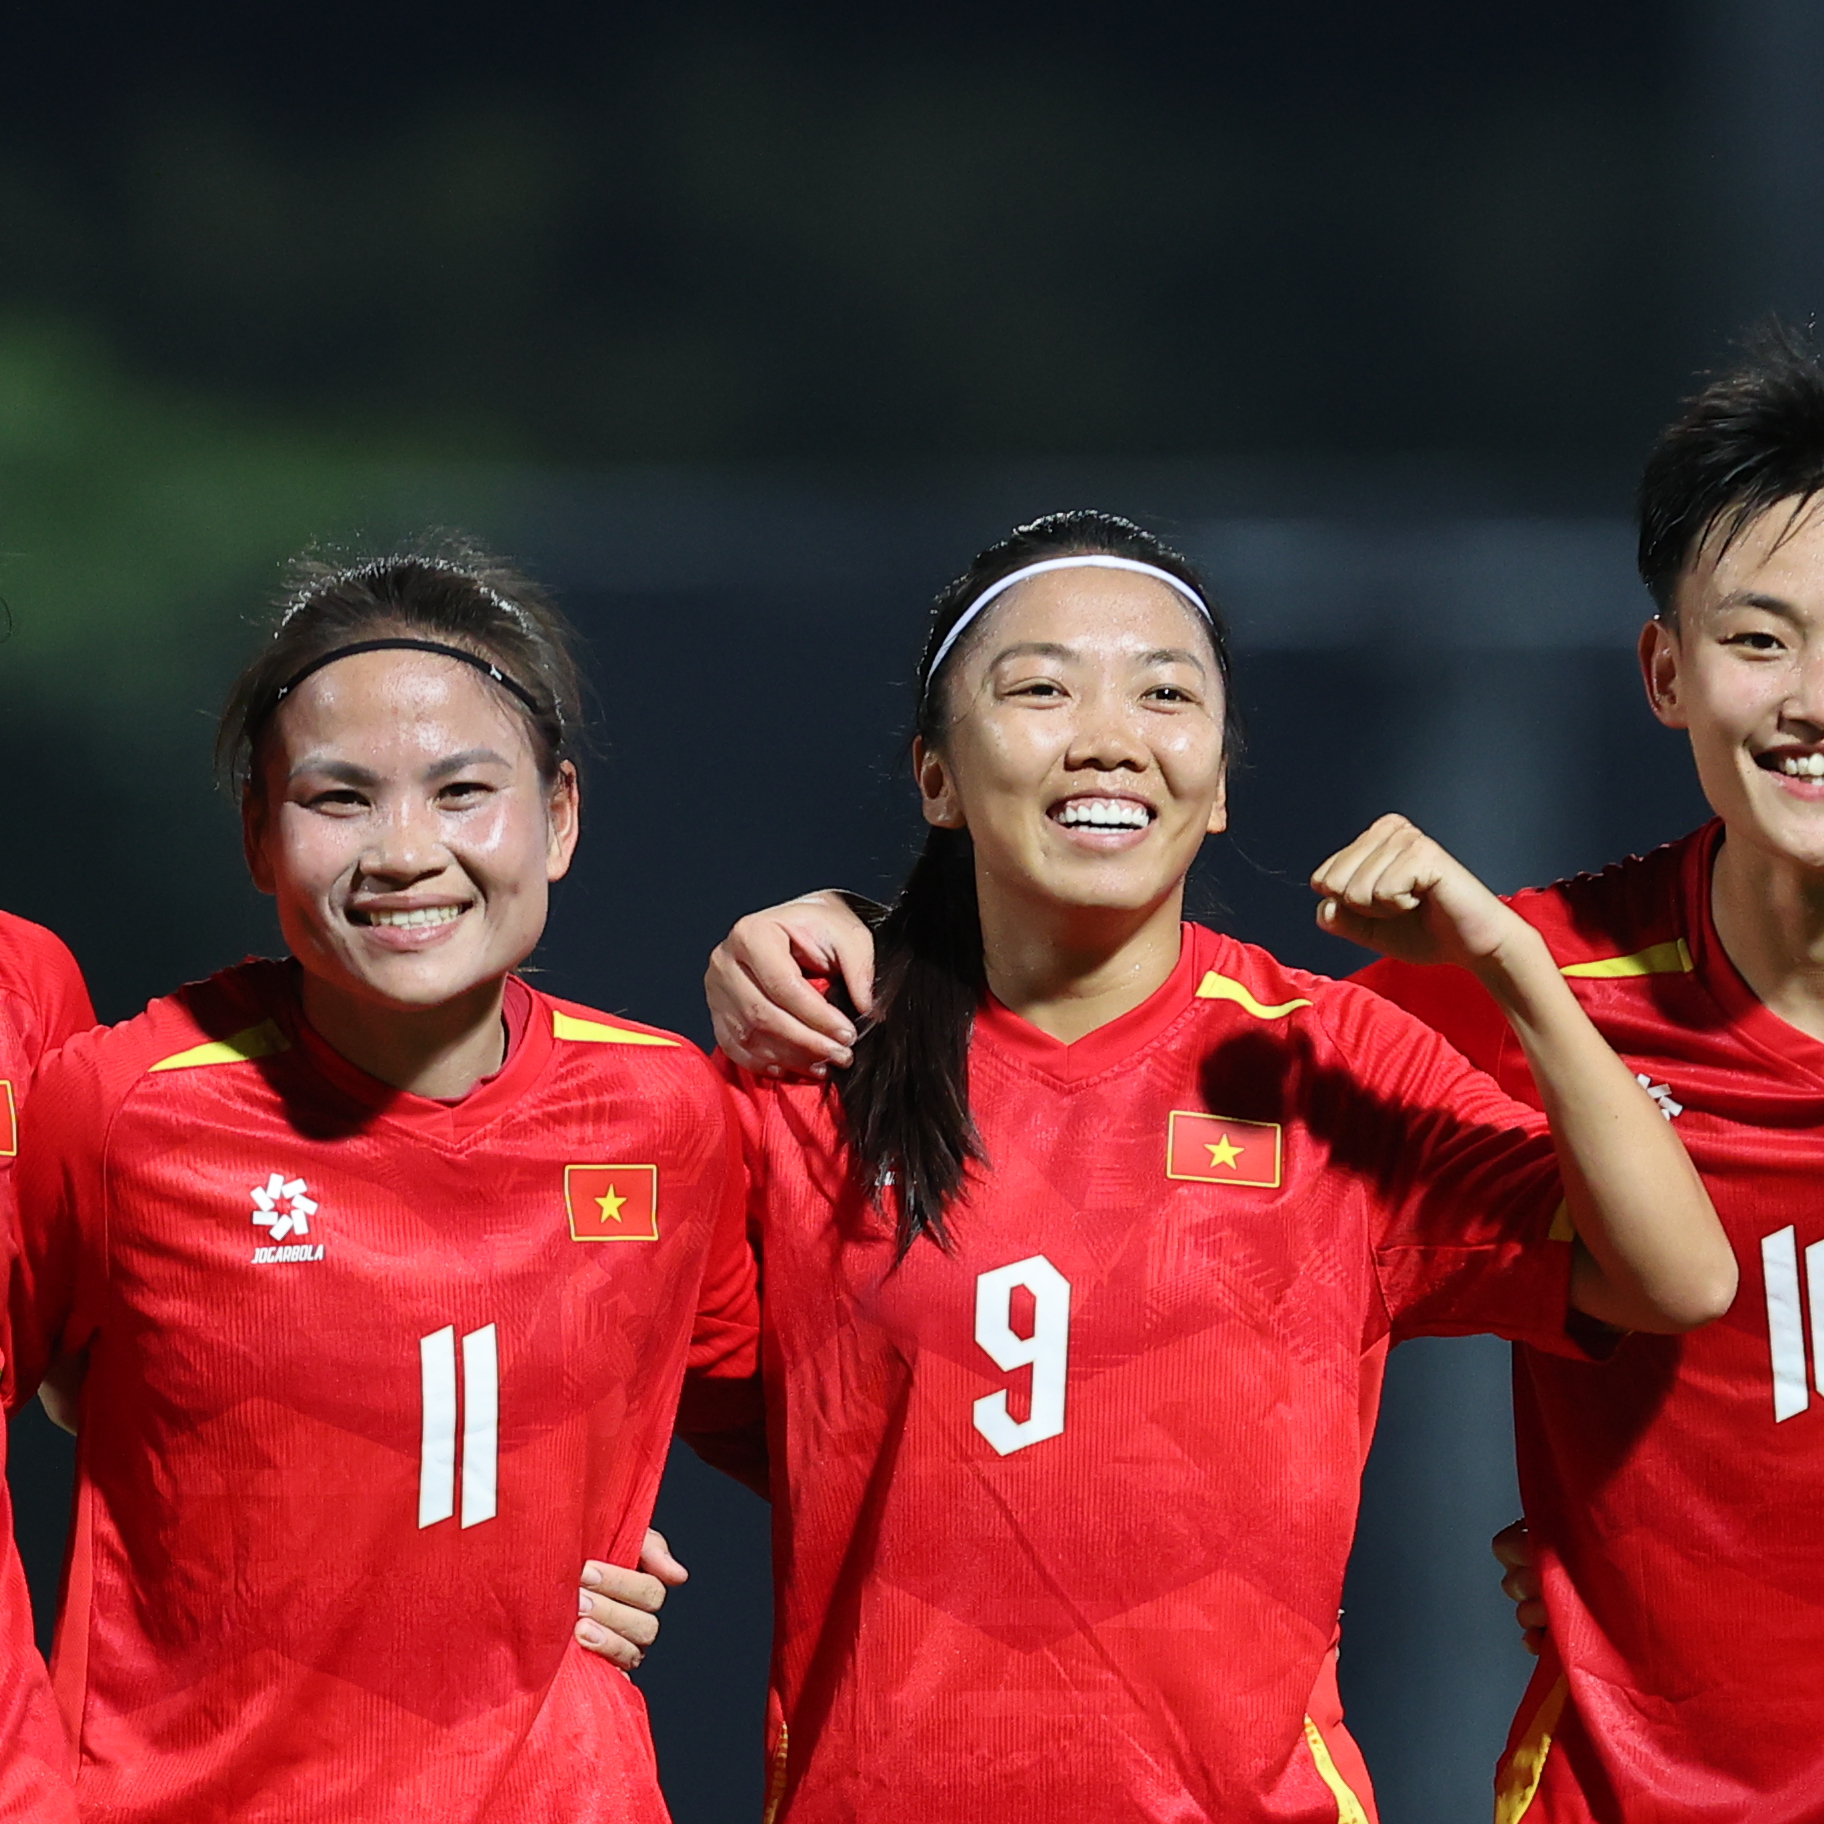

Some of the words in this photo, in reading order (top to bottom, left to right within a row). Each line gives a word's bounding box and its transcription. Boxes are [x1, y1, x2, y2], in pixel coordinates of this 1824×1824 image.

[250, 1243, 325, 1265] JOGARBOLA
[972, 1254, 1072, 1457] 9
[417, 1321, 499, 1531] 11
